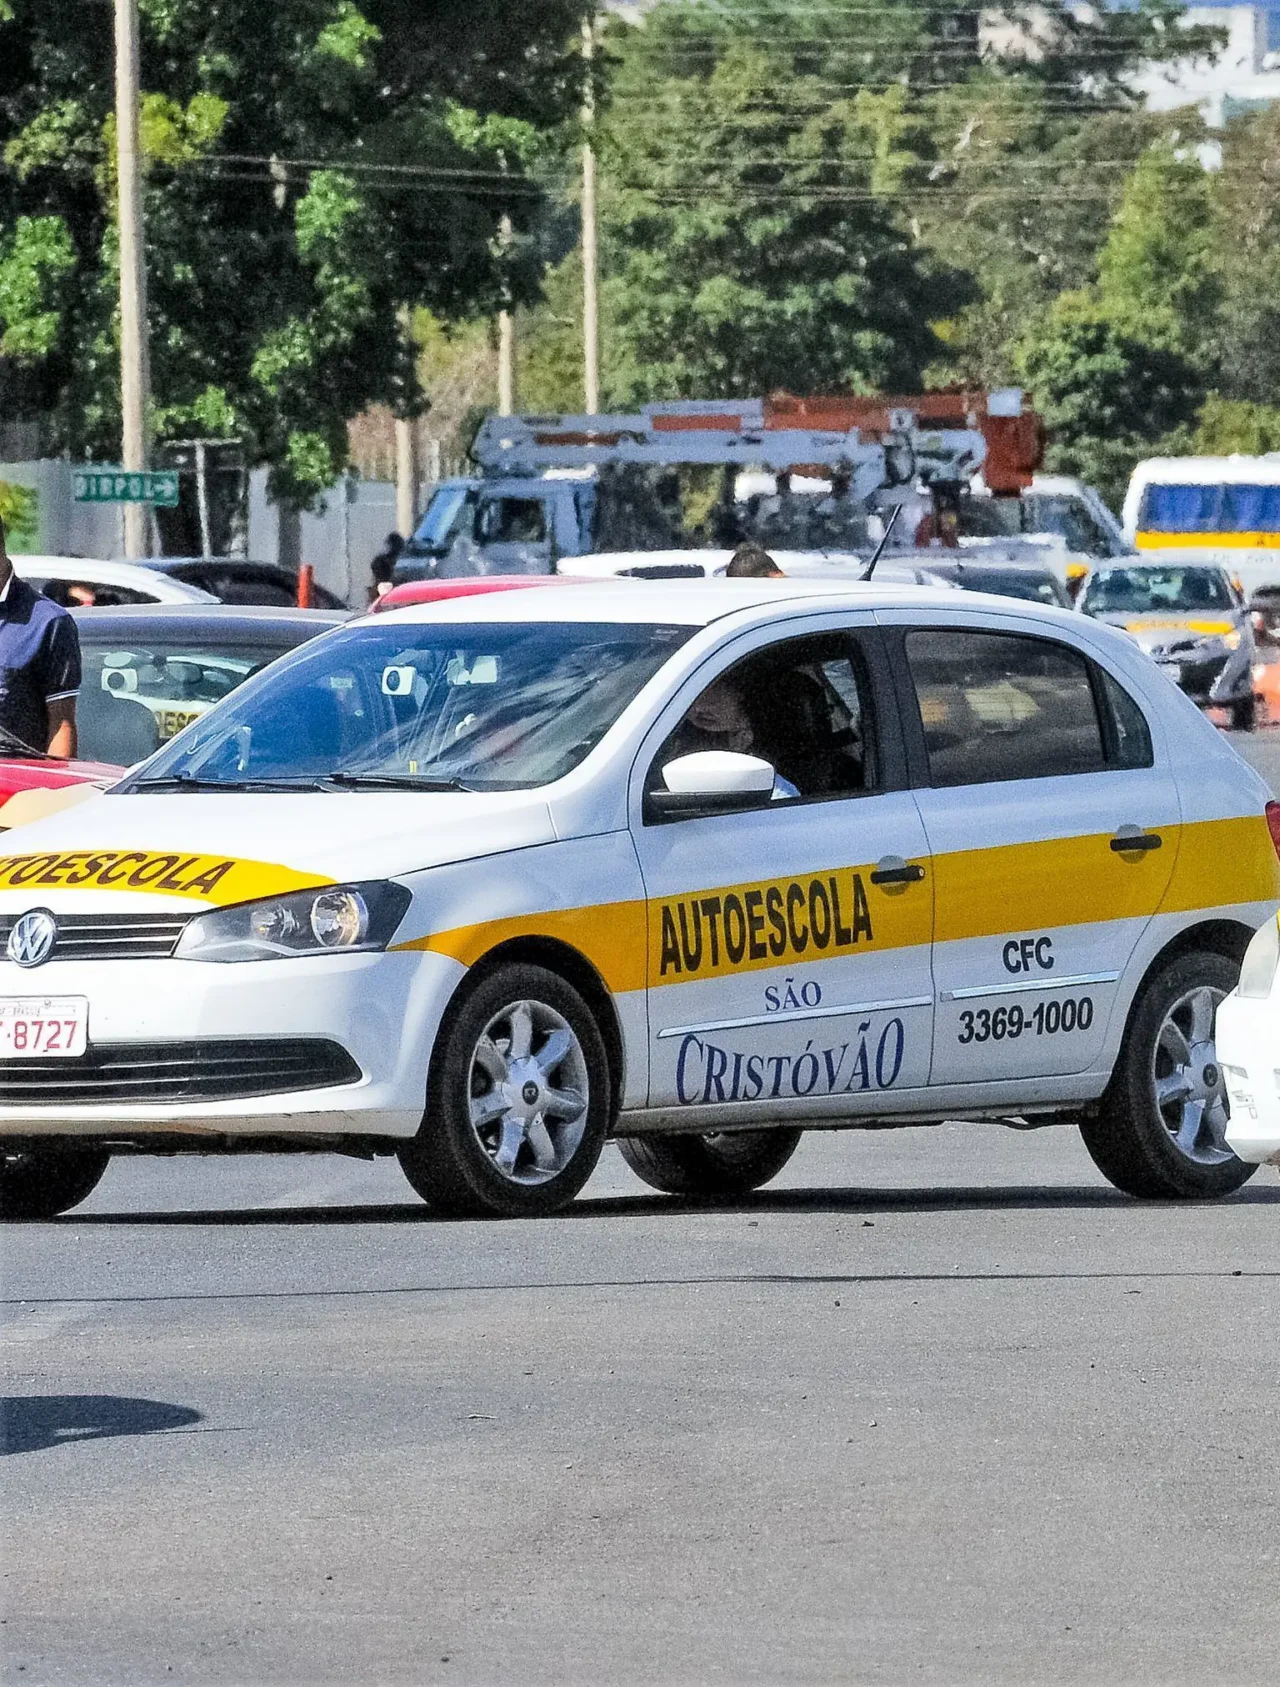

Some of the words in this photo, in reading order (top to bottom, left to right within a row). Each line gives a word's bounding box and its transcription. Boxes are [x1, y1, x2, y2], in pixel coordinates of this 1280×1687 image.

[0, 852, 235, 894] TOESCOLA
[661, 874, 873, 976] AUTOESCOLA
[1002, 937, 1054, 973] CFC
[764, 977, 822, 1012] SÃO
[958, 997, 1093, 1044] 3369-1000
[676, 1017, 904, 1106] CRISTÓVÃO
